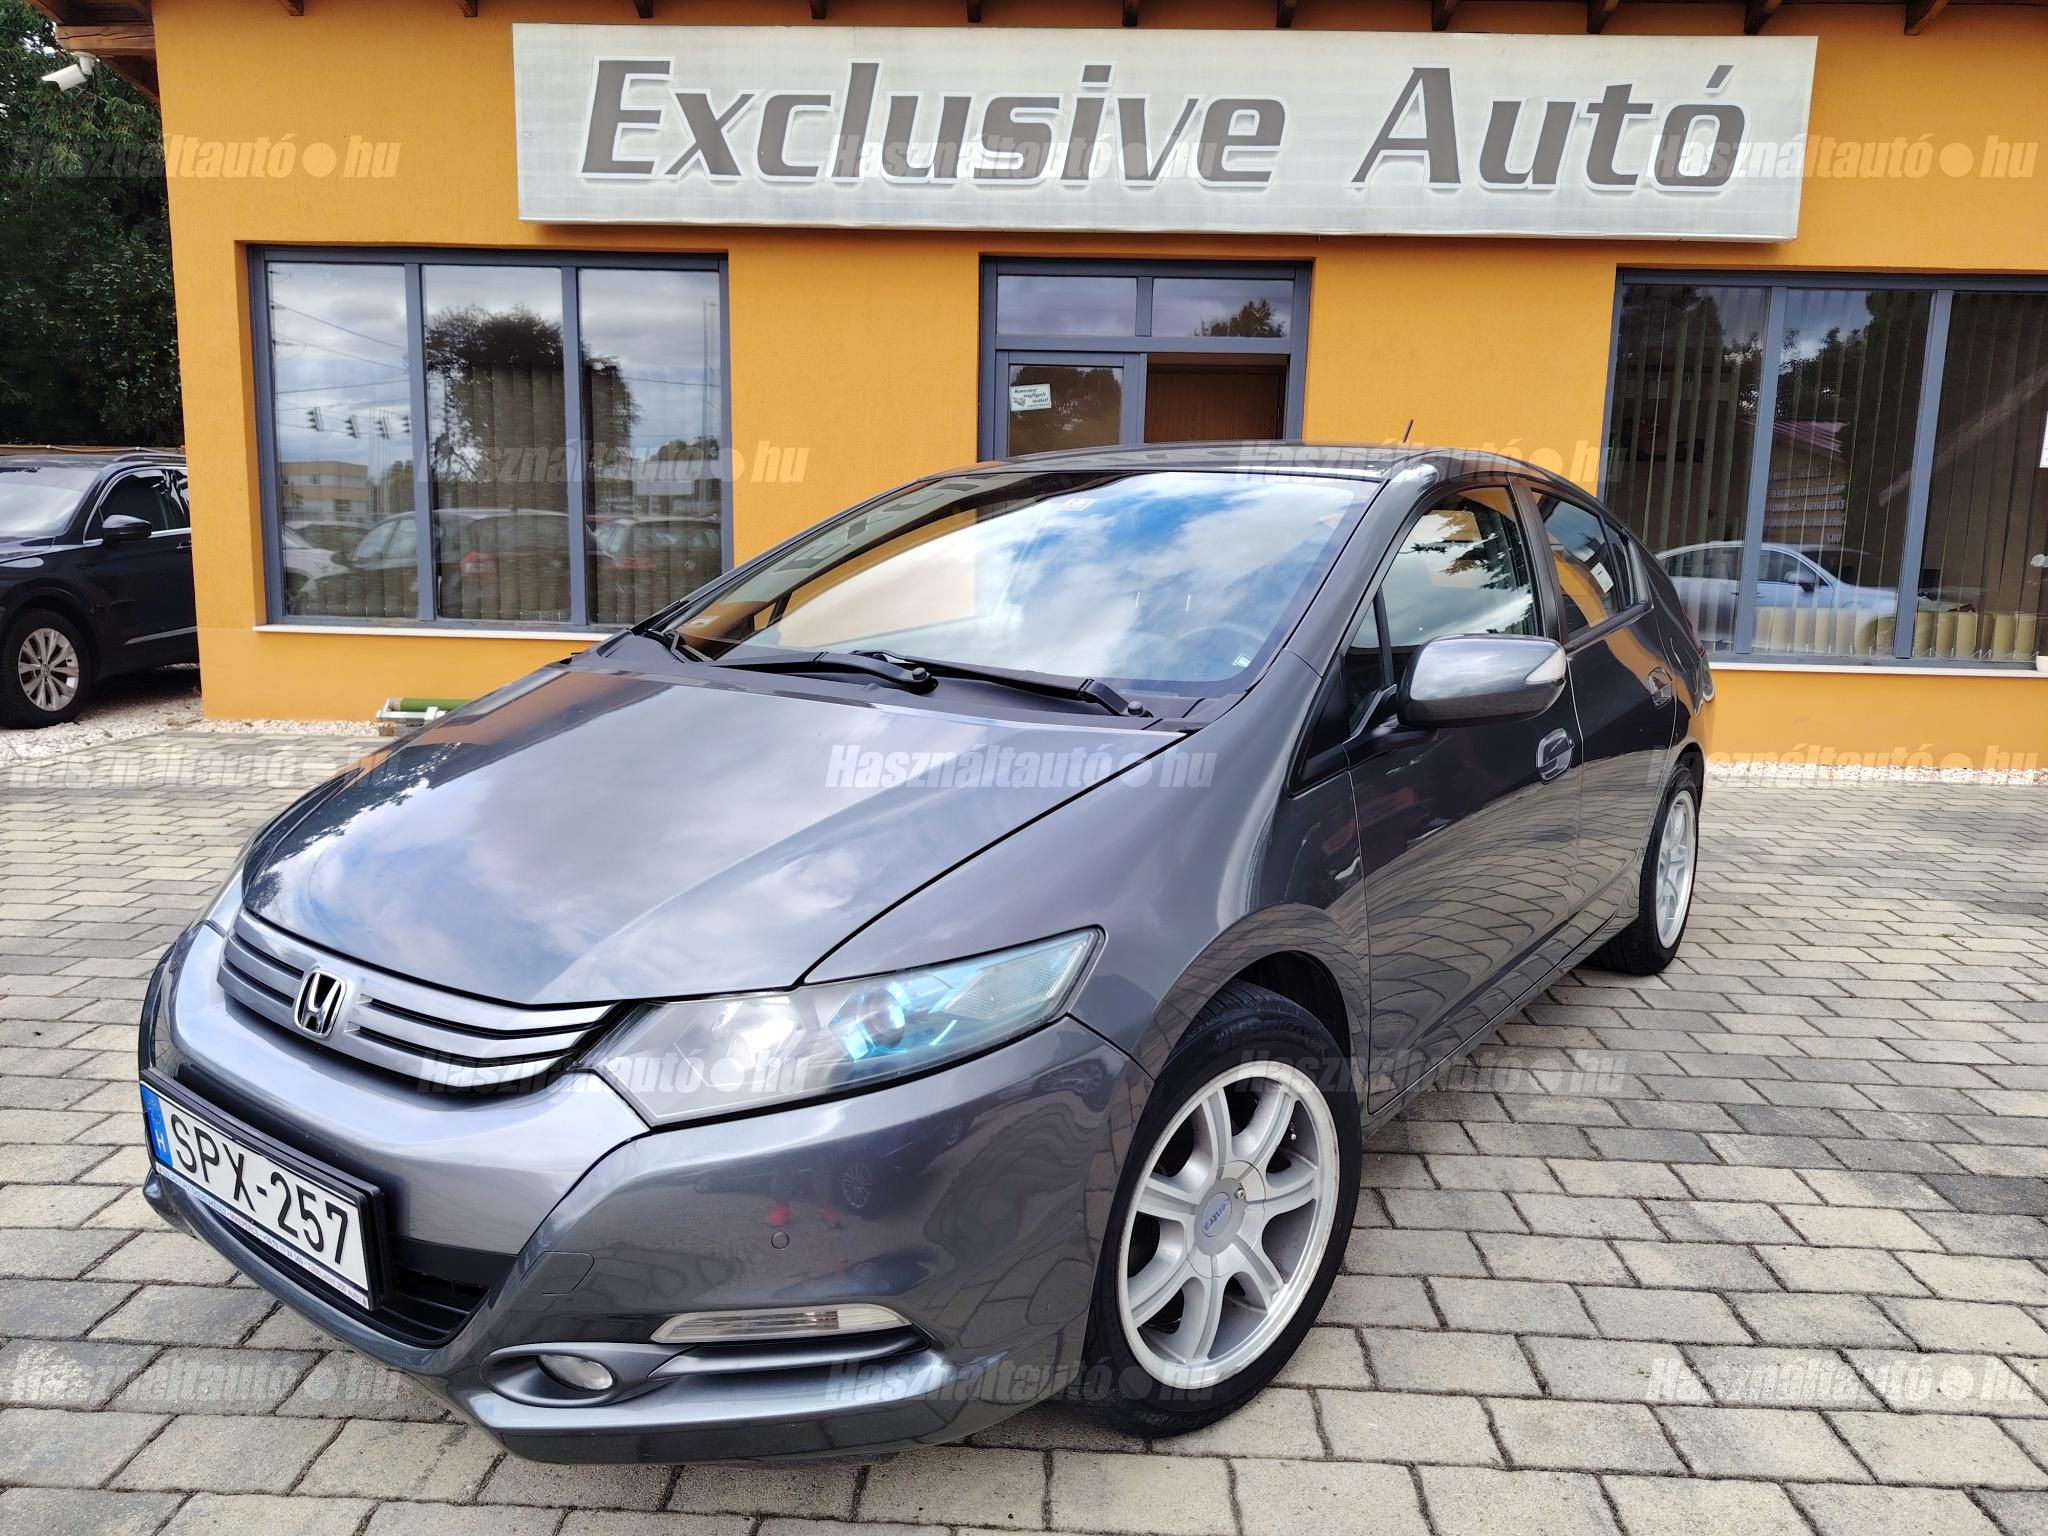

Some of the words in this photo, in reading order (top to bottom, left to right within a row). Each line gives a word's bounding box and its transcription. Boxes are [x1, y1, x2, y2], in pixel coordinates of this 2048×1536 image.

[577, 56, 1287, 188] Exclusive
[1350, 63, 1748, 190] Autó
[156, 1132, 167, 1153] H
[170, 1113, 349, 1265] SPX-257
